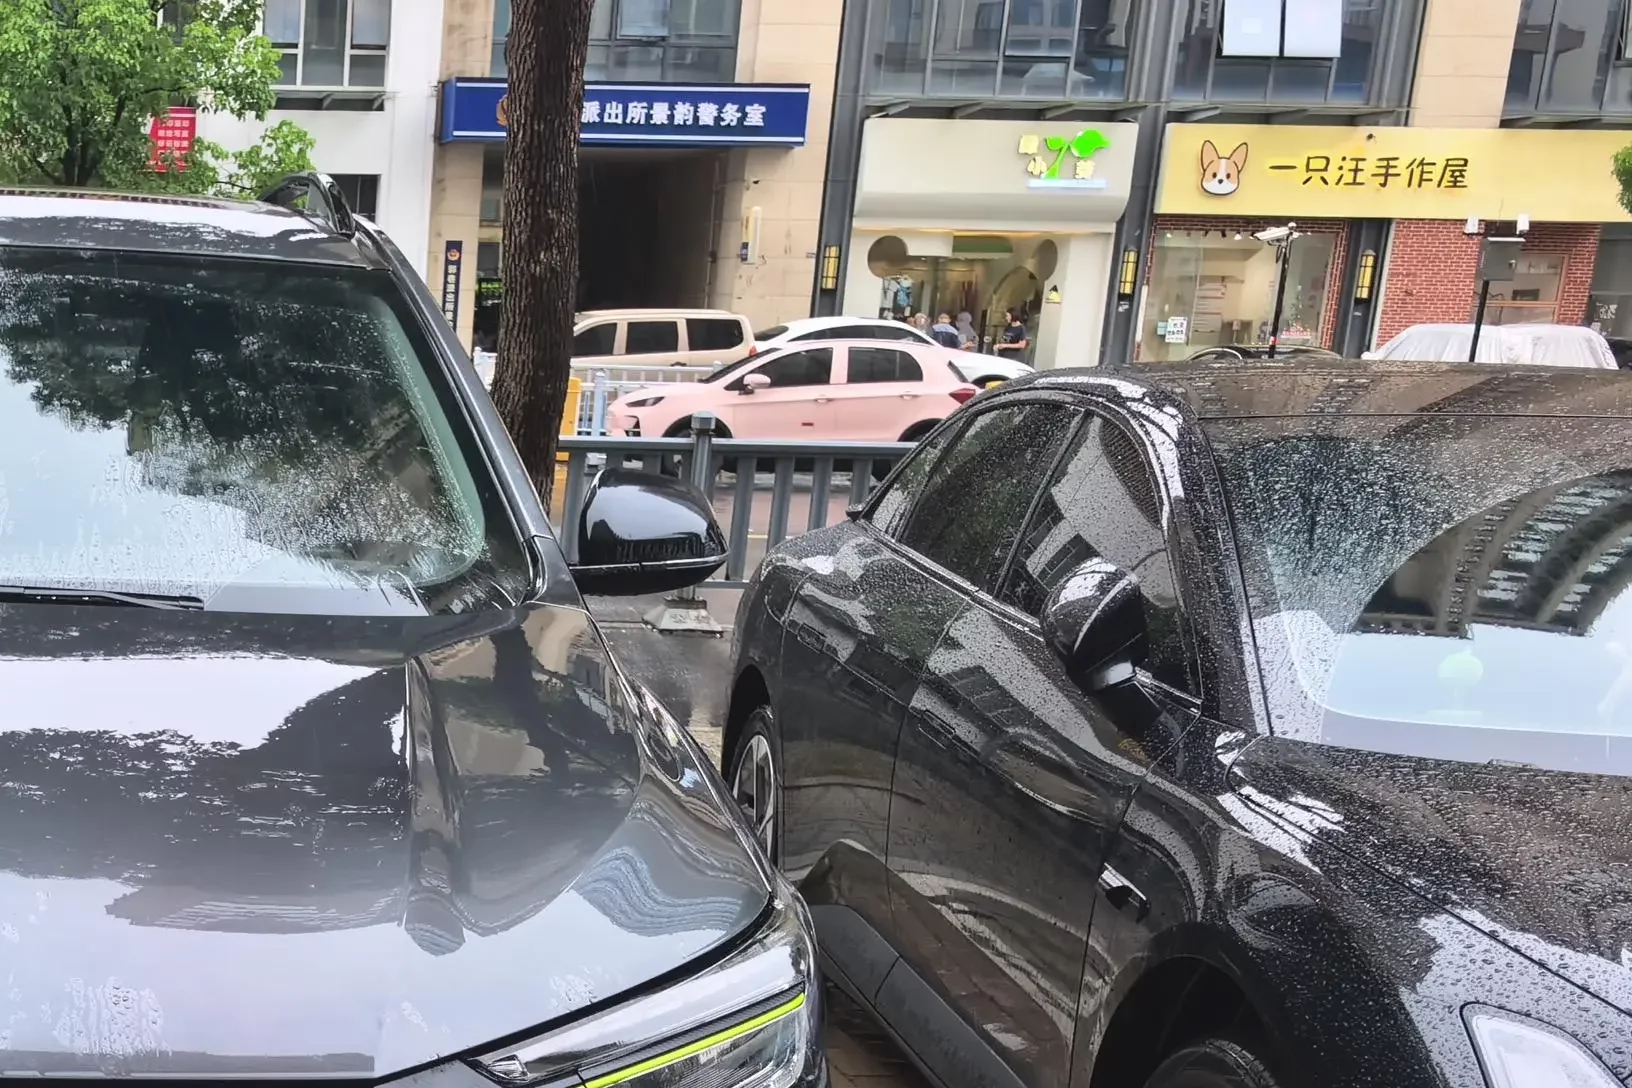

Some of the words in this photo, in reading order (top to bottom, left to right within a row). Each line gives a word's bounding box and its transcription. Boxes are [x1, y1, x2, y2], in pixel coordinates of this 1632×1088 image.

[1268, 155, 1469, 189] 一只汪手作屋
